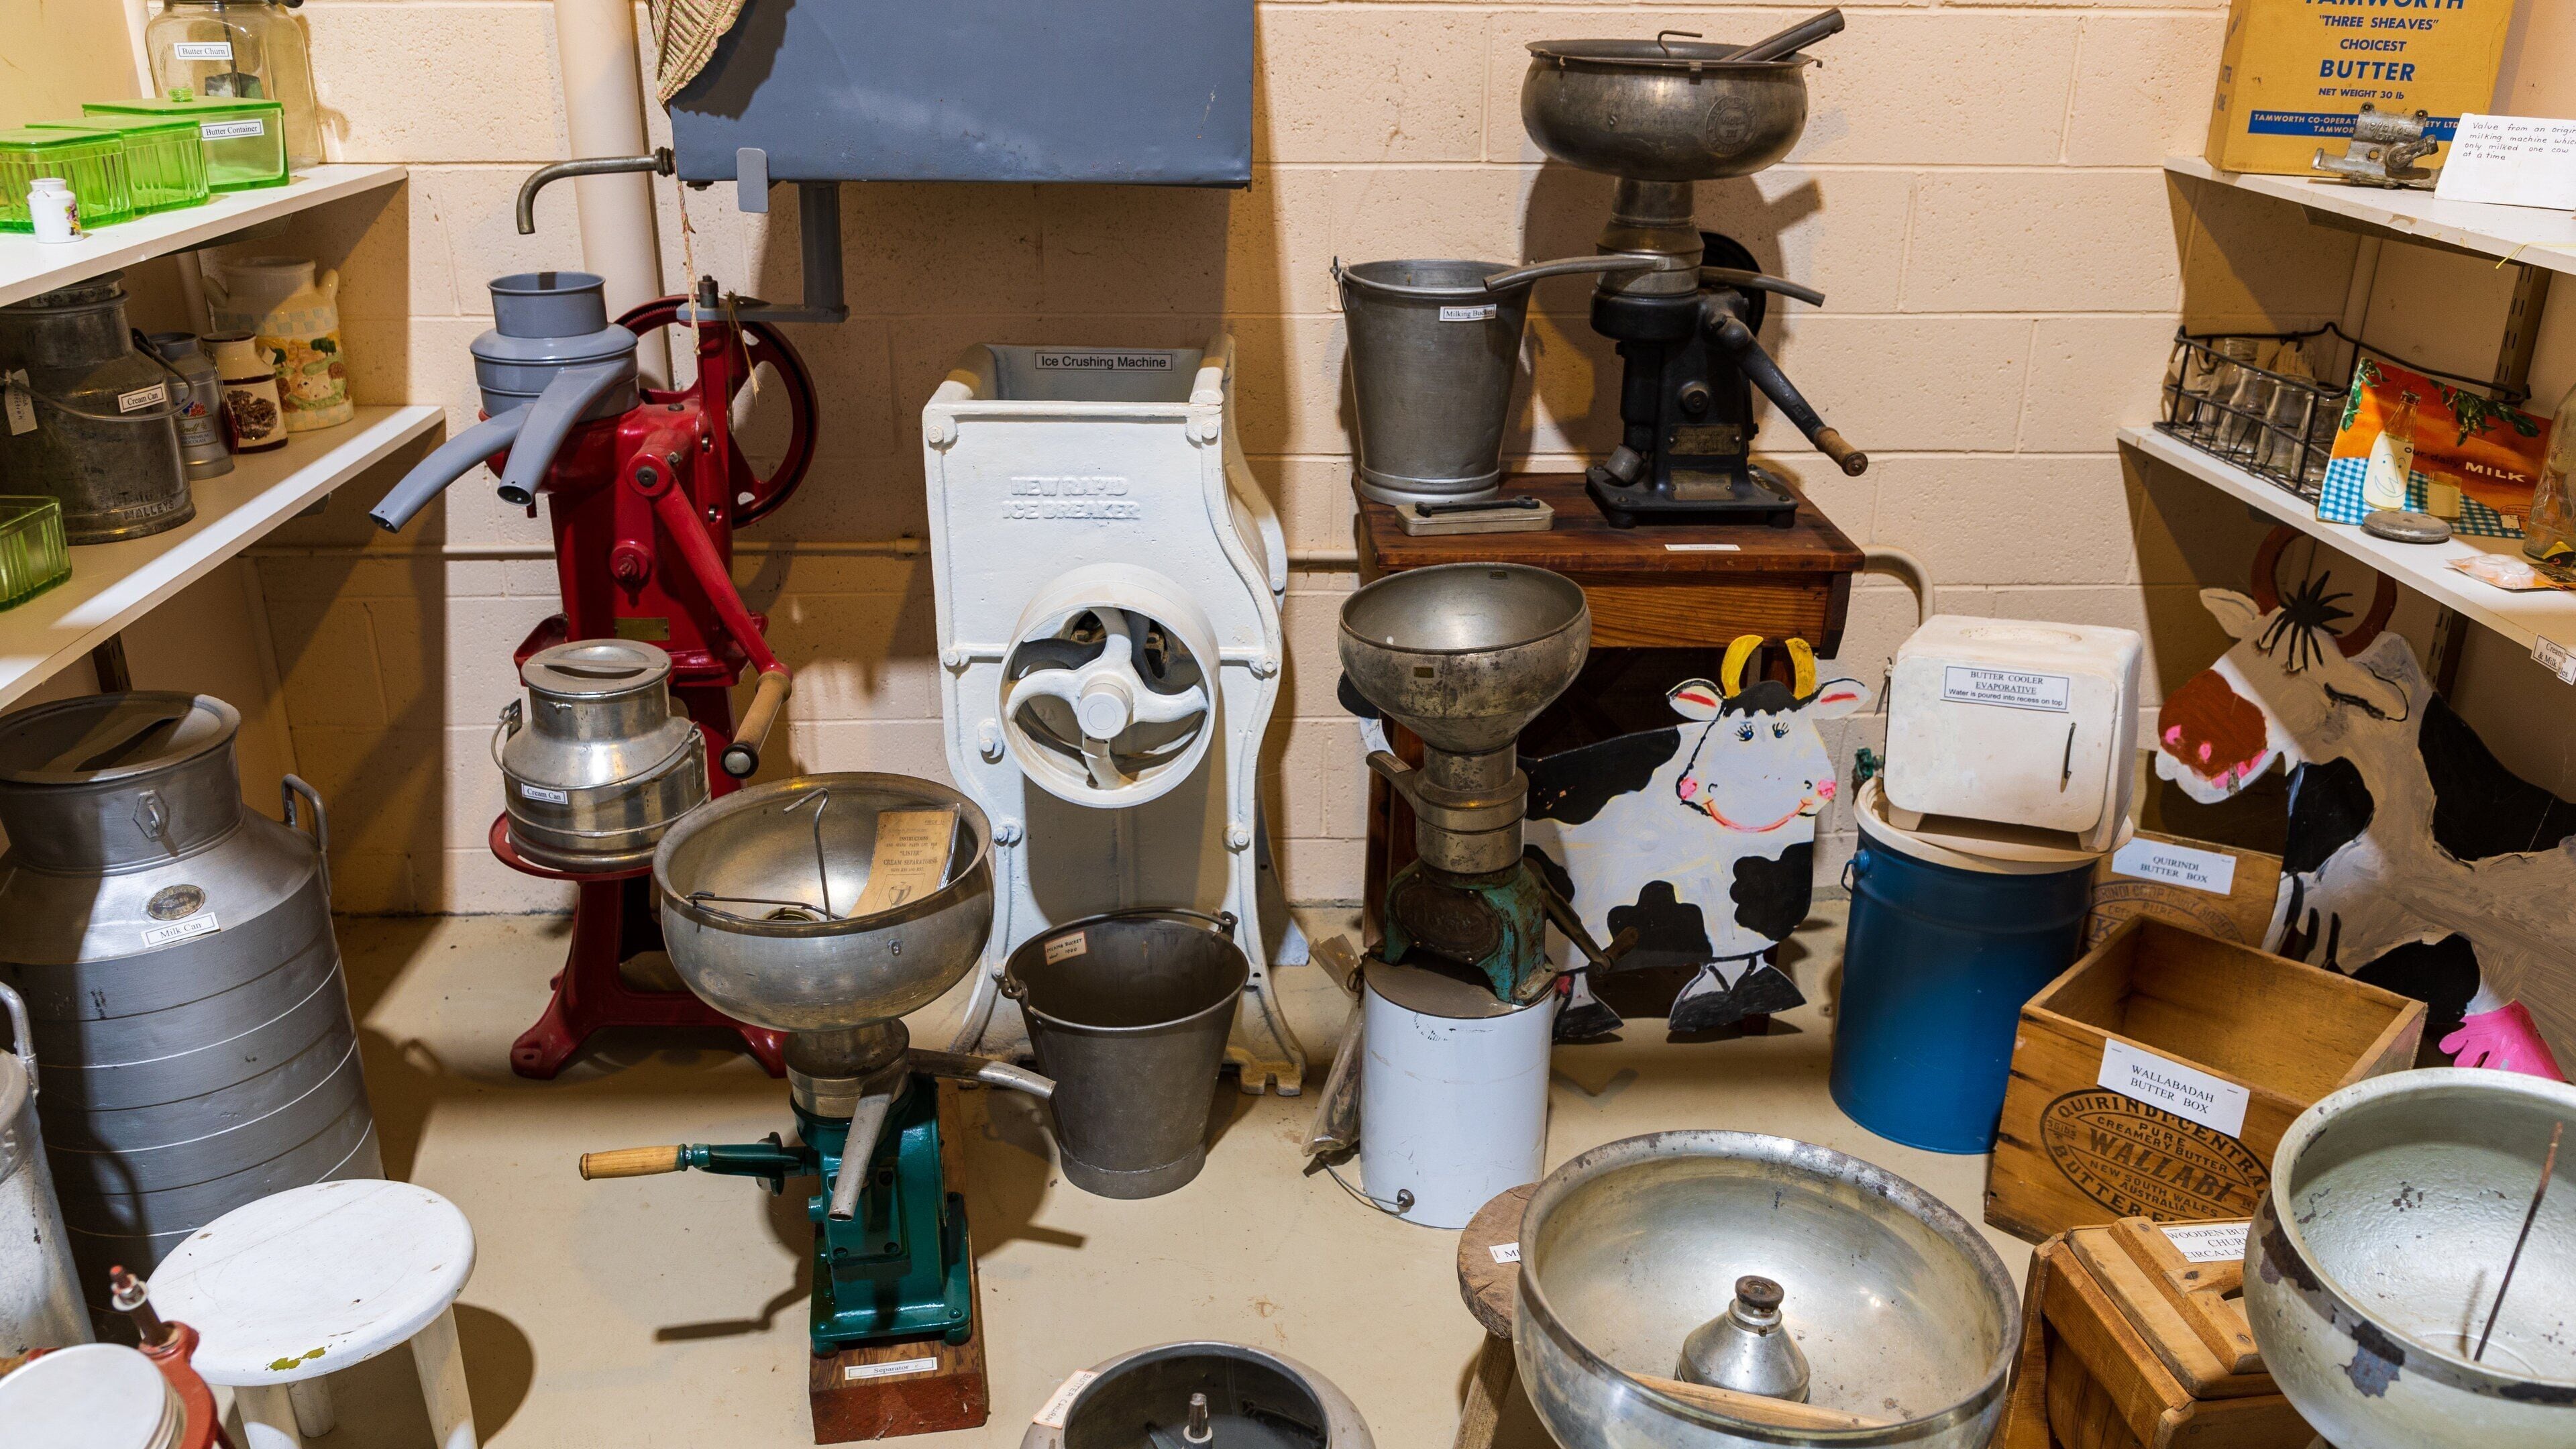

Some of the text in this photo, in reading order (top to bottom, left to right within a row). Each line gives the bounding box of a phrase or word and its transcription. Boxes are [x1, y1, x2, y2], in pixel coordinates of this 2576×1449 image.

[2319, 15, 2439, 30] "THREE SHEAVES"
[2340, 38, 2407, 52] CHOICEST
[2319, 59, 2416, 82] BUTTER
[2318, 88, 2404, 100] NET WEIGHT 30 lb
[2254, 113, 2306, 123] TAMWORTH
[2308, 115, 2357, 125] CO-OPERAT
[206, 125, 258, 136] Butter Container
[2314, 125, 2354, 134] TAMWOR
[2473, 121, 2499, 131] Value
[2508, 123, 2528, 132] from
[2469, 133, 2576, 145] milking machine whic
[2465, 142, 2482, 151] only
[2488, 143, 2520, 152] milked
[2486, 151, 2506, 160] time
[1446, 309, 1493, 319] Milking Bucket
[1042, 356, 1167, 370] Ice Crushing Machine
[127, 392, 158, 406] Cream Can
[2404, 446, 2526, 482] our daily MILK
[1010, 476, 1059, 496] NEW
[1002, 500, 1140, 520] ICE BREAKER
[2538, 651, 2557, 667] & Milk
[1970, 671, 2043, 685] BUTTER COOLER
[1949, 688, 1969, 696] Water
[1978, 692, 2001, 700] poured
[1976, 682, 2037, 694] EVAPORATIVE
[527, 788, 561, 800] Cream Can
[2152, 855, 2200, 871] QUIRINDI
[2140, 863, 2209, 883] BUTTER BOX
[160, 922, 202, 939] Milk Can
[2132, 1065, 2214, 1103] WALLABADAH
[2130, 1077, 2210, 1114] BUTTER BOX
[2138, 1122, 2186, 1148] PURE
[2097, 1116, 2228, 1173] CREAMERY BUTTER
[2090, 1127, 2236, 1203] WALLABI
[2053, 1144, 2143, 1218] BUTTER
[2090, 1160, 2121, 1177] NEW
[2125, 1173, 2168, 1197] SOUTH
[2174, 1193, 2218, 1218] WALES
[2119, 1181, 2187, 1213] AUSTRALIA
[2166, 1227, 2249, 1240] WOODEN BUT
[873, 1365, 909, 1374] Separator
[1044, 1373, 1092, 1421] BUTTER CHURN
